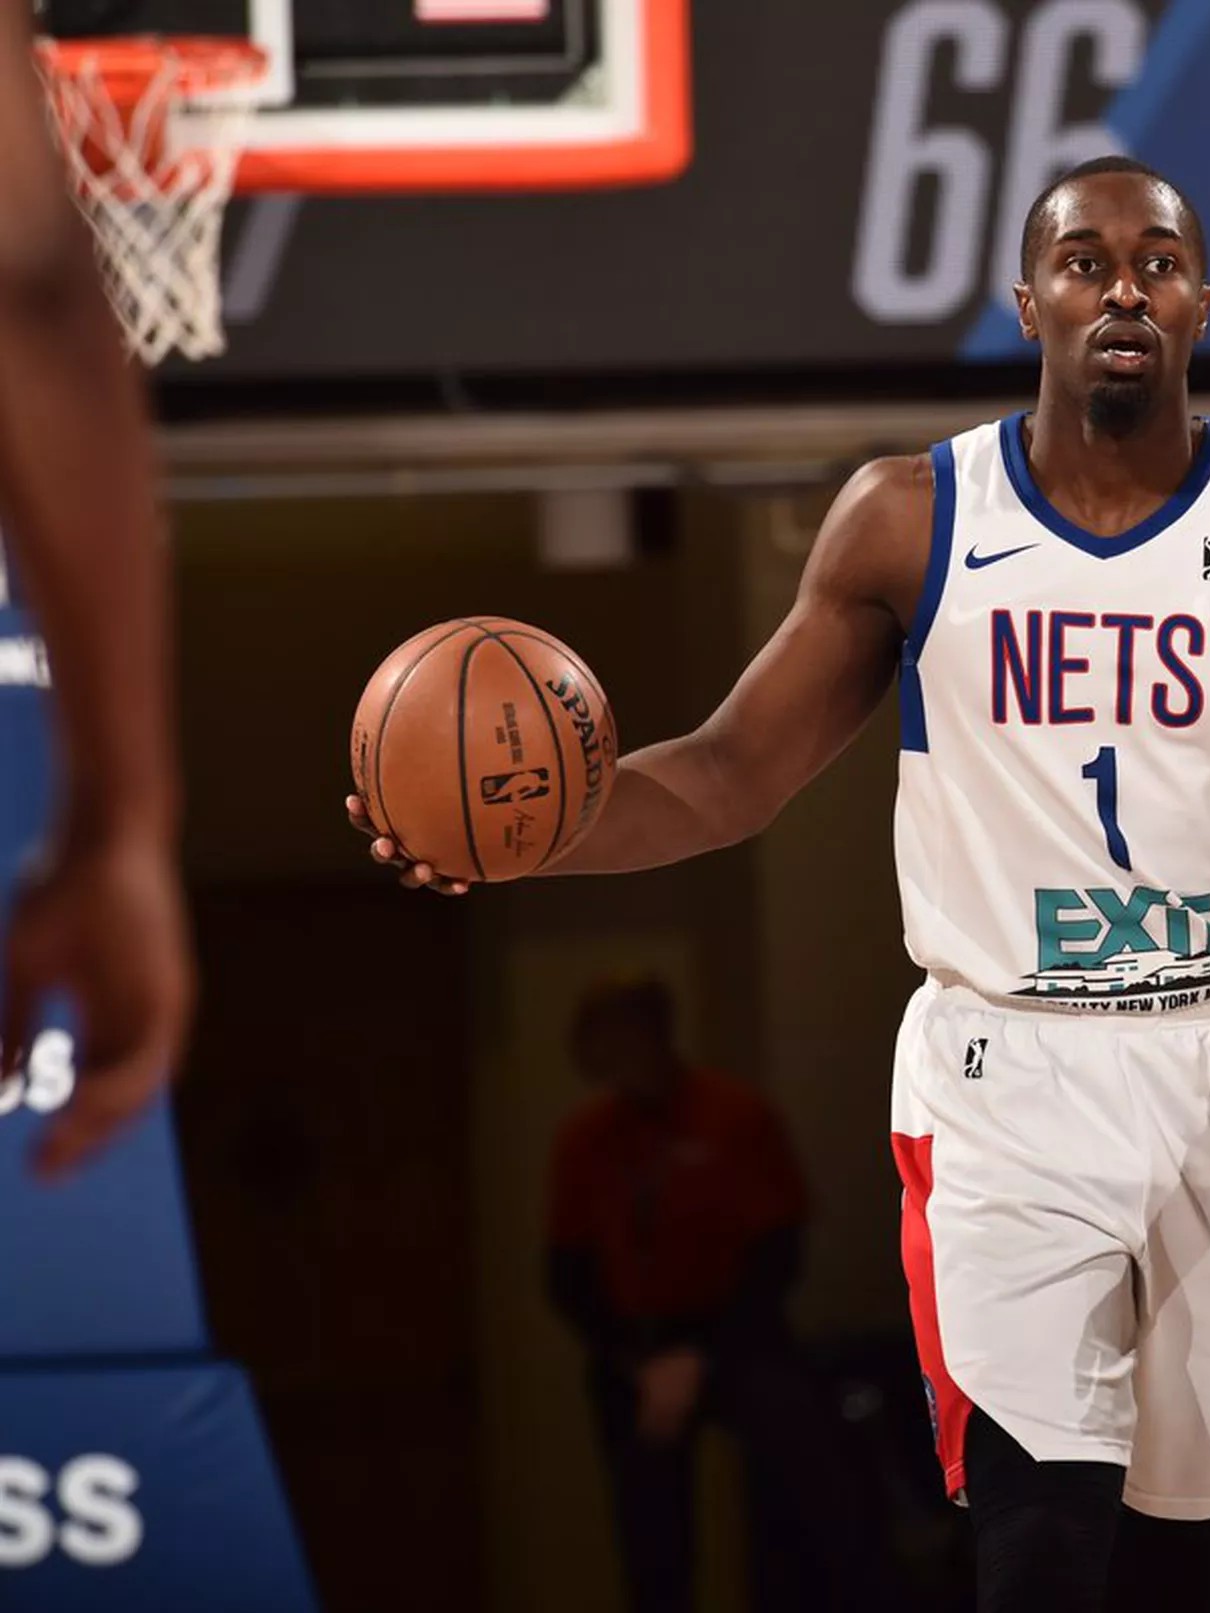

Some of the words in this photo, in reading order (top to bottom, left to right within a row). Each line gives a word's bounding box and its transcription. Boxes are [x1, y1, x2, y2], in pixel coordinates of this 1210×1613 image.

[991, 609, 1205, 728] NETS
[1082, 745, 1133, 872] 1
[1116, 997, 1153, 1012] NEW
[1158, 991, 1200, 1012] YORK
